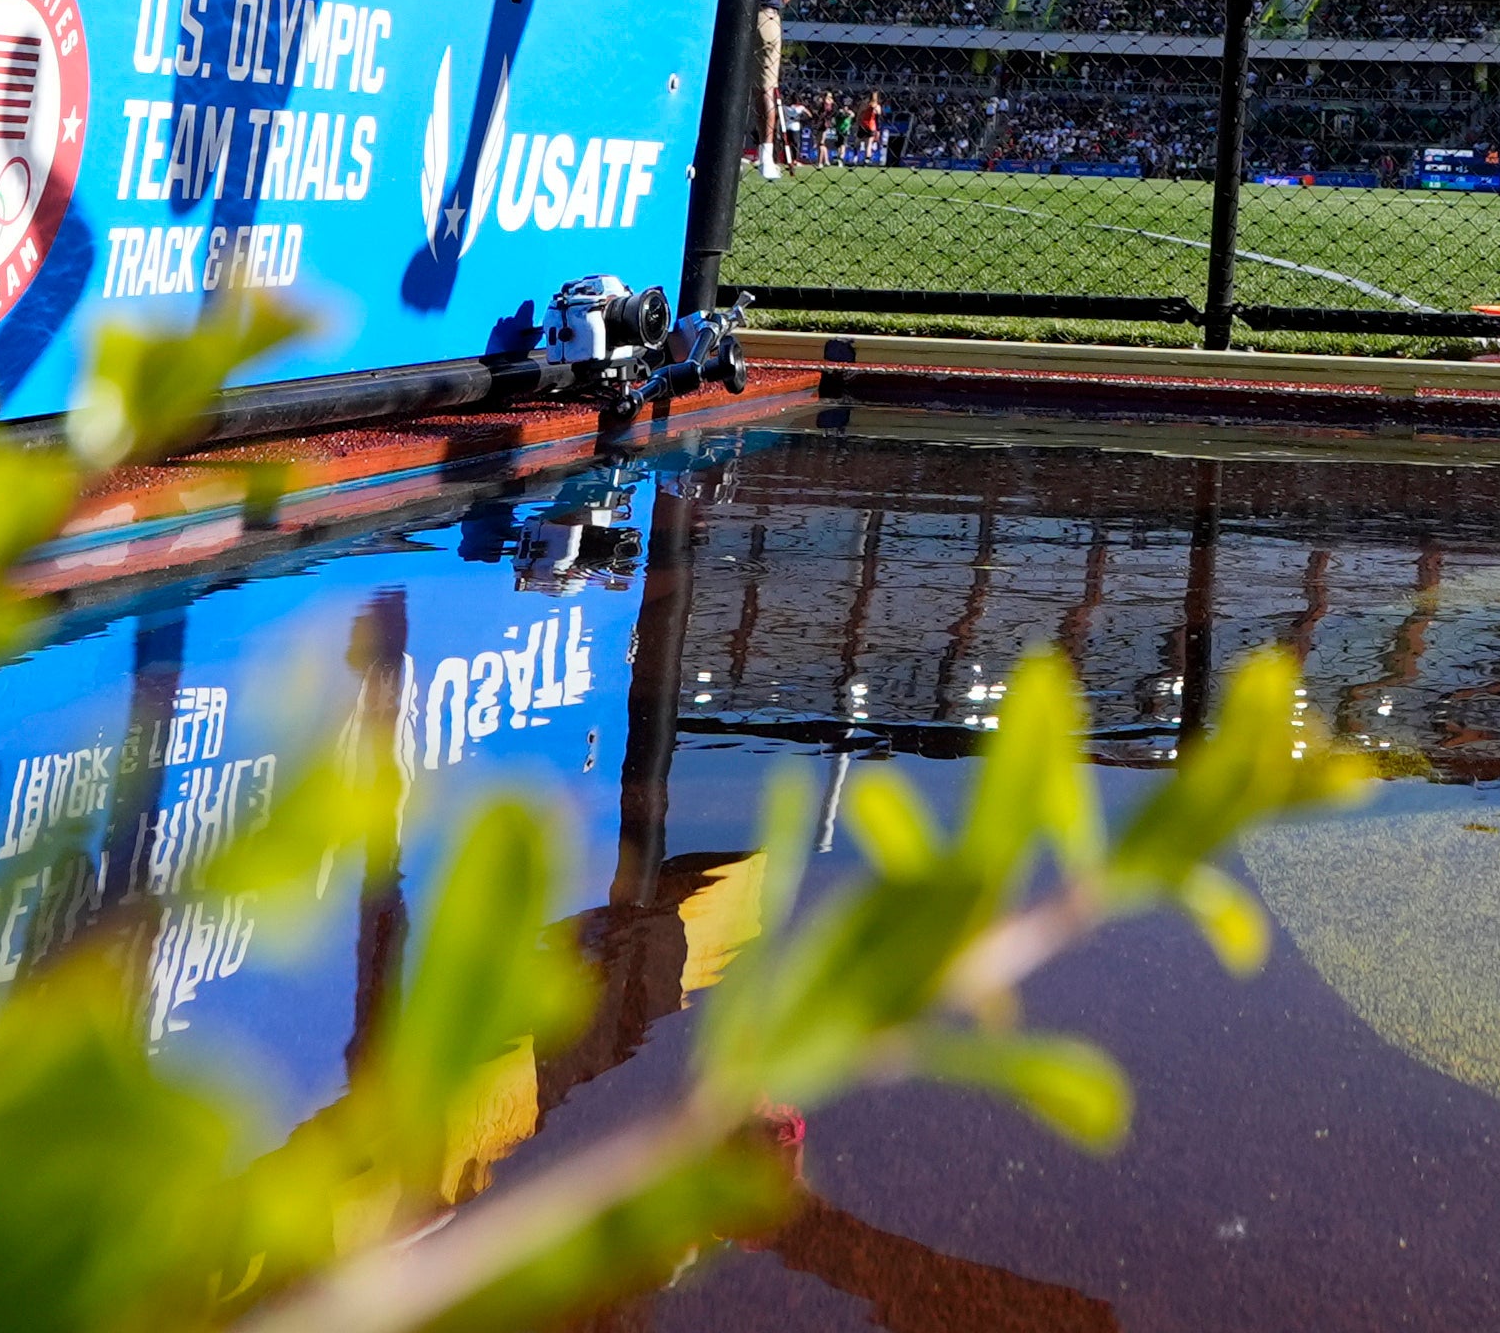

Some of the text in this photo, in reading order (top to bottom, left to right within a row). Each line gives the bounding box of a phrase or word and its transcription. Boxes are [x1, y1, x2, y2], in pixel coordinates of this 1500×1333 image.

[117, 99, 377, 201] TEAM TRIALS
[497, 133, 664, 231] USATF
[102, 223, 302, 298] TRACK & FIELD
